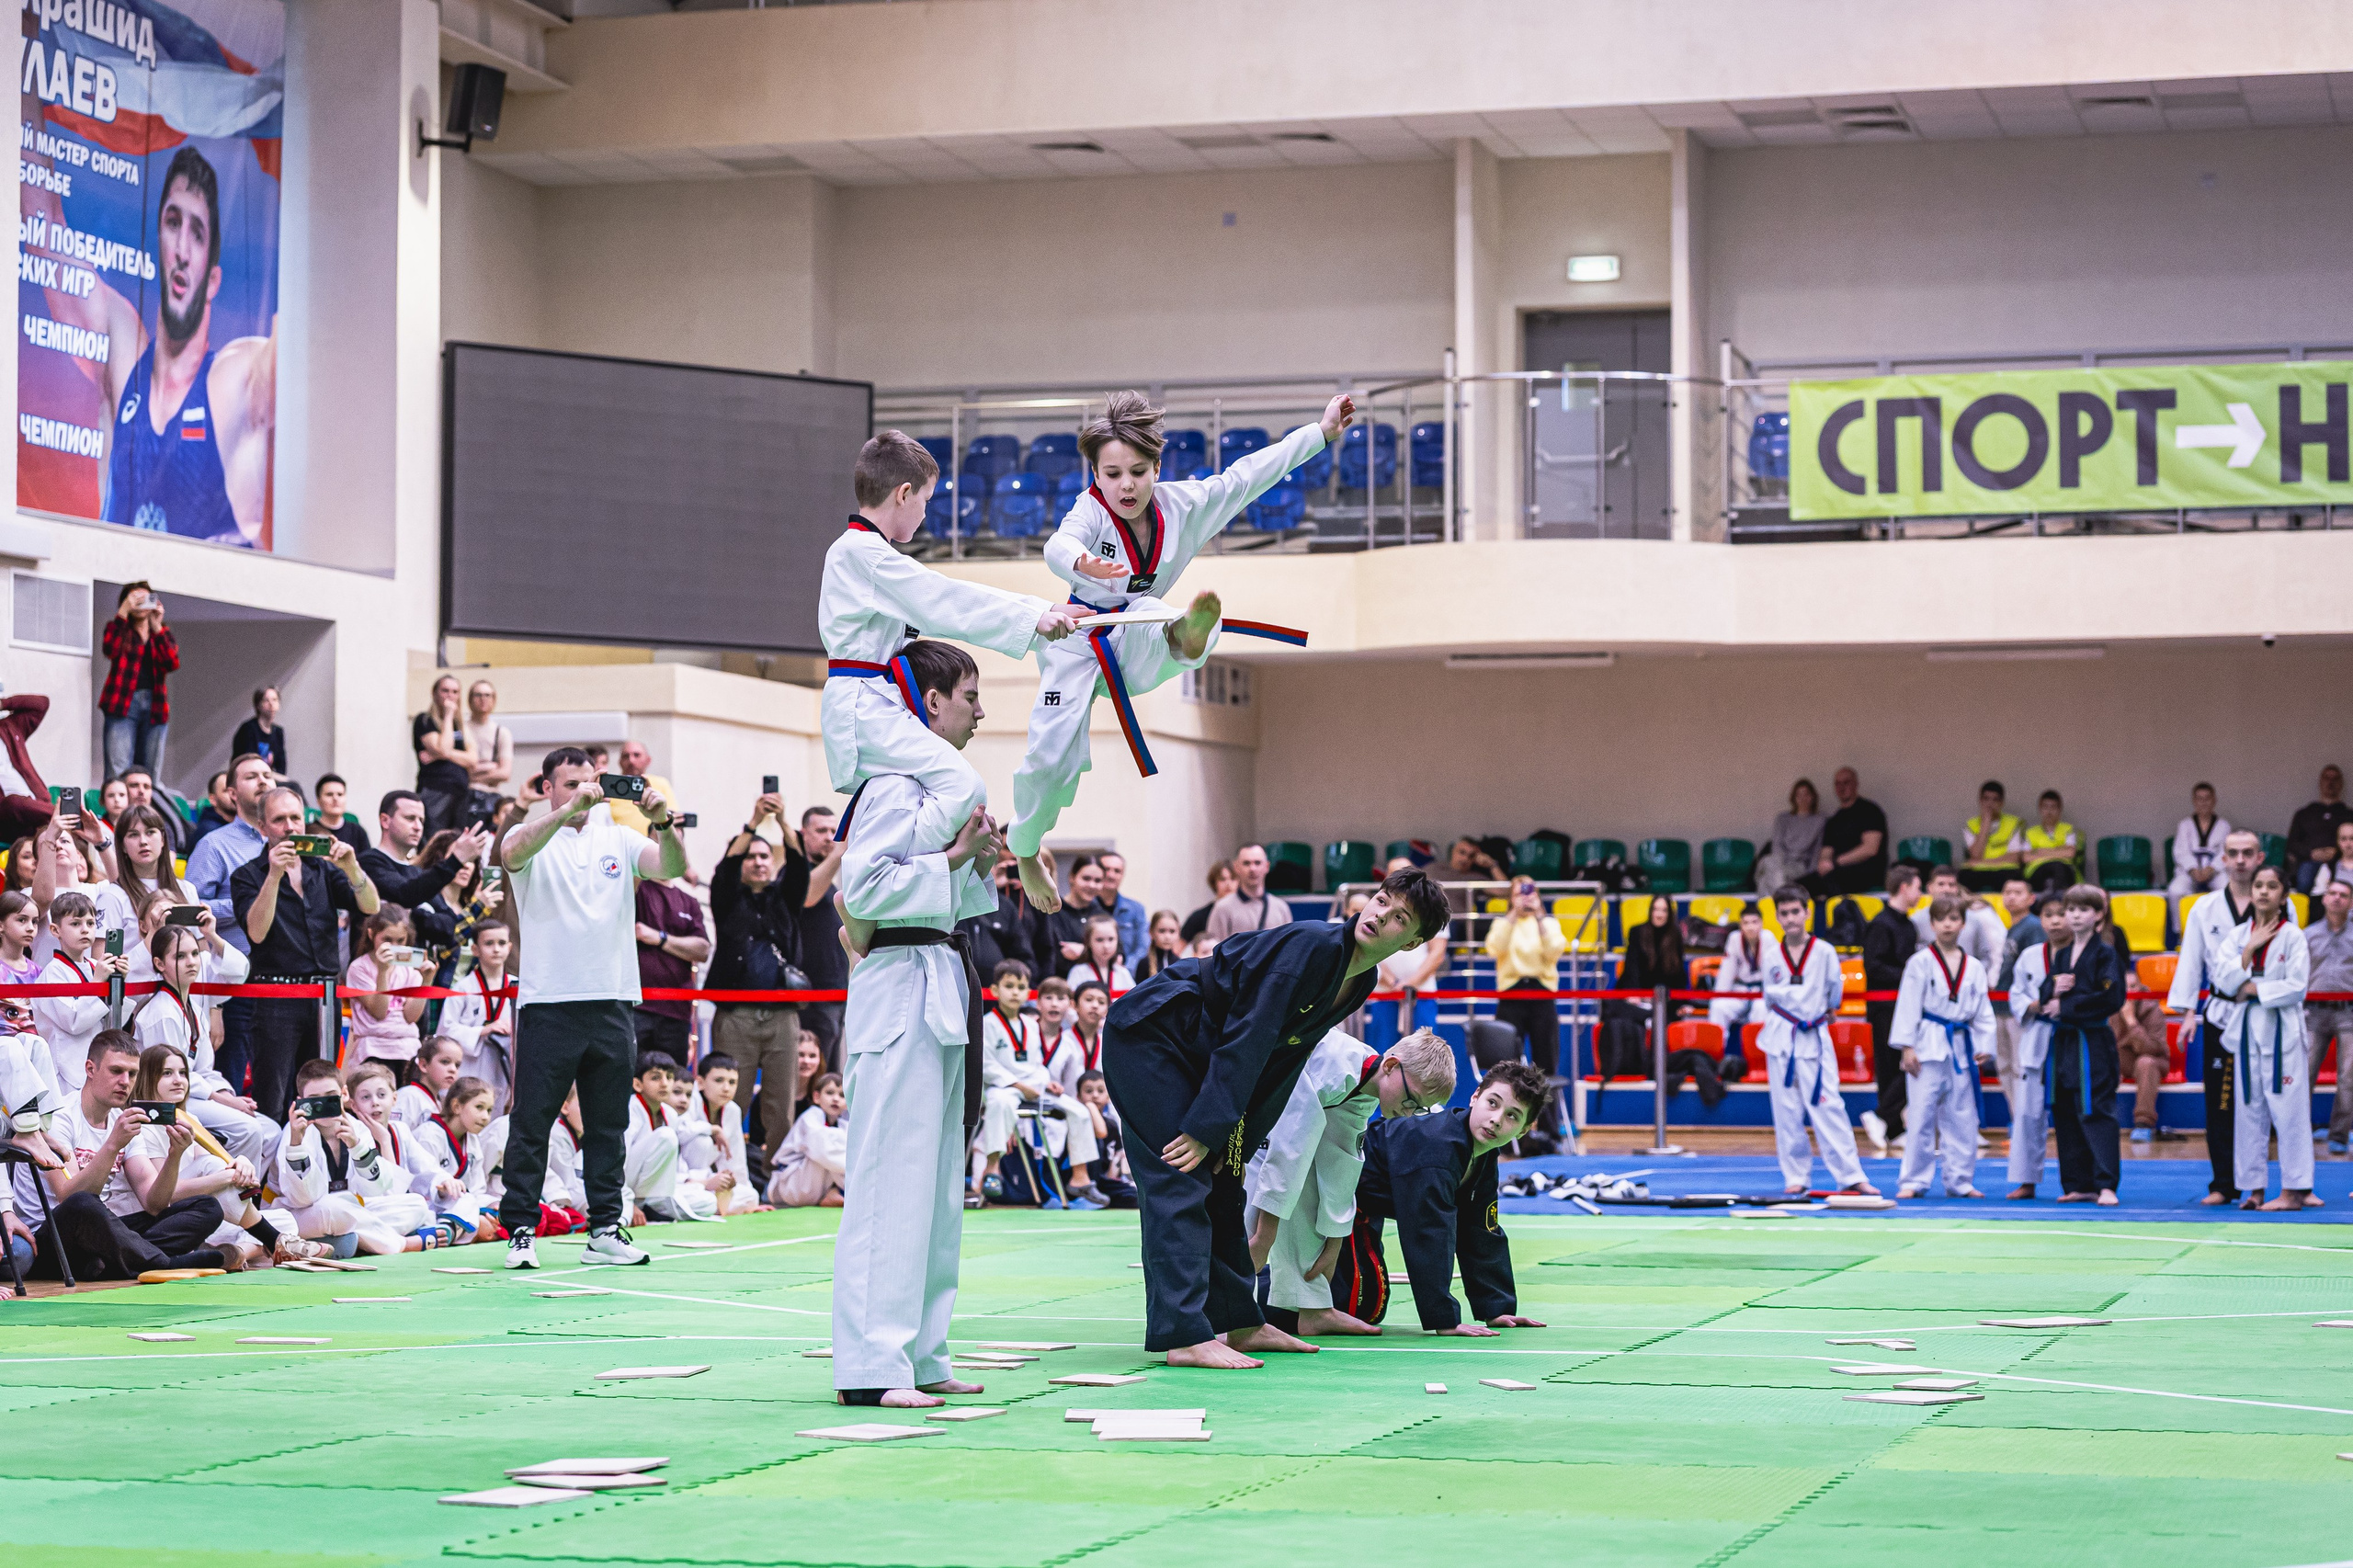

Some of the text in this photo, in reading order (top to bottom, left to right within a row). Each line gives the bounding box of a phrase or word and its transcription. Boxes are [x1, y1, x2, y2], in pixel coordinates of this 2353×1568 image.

[37, 131, 90, 167] МАСТЕР
[91, 150, 139, 187] СПОРТА
[50, 222, 156, 280] ПОБЕДИТЕЛЬ
[62, 264, 97, 299] ИГР
[23, 314, 109, 364] ЧЕМПИОН
[20, 413, 105, 460] ЧЕМПИОН
[1817, 388, 2177, 496] СПОРТ
